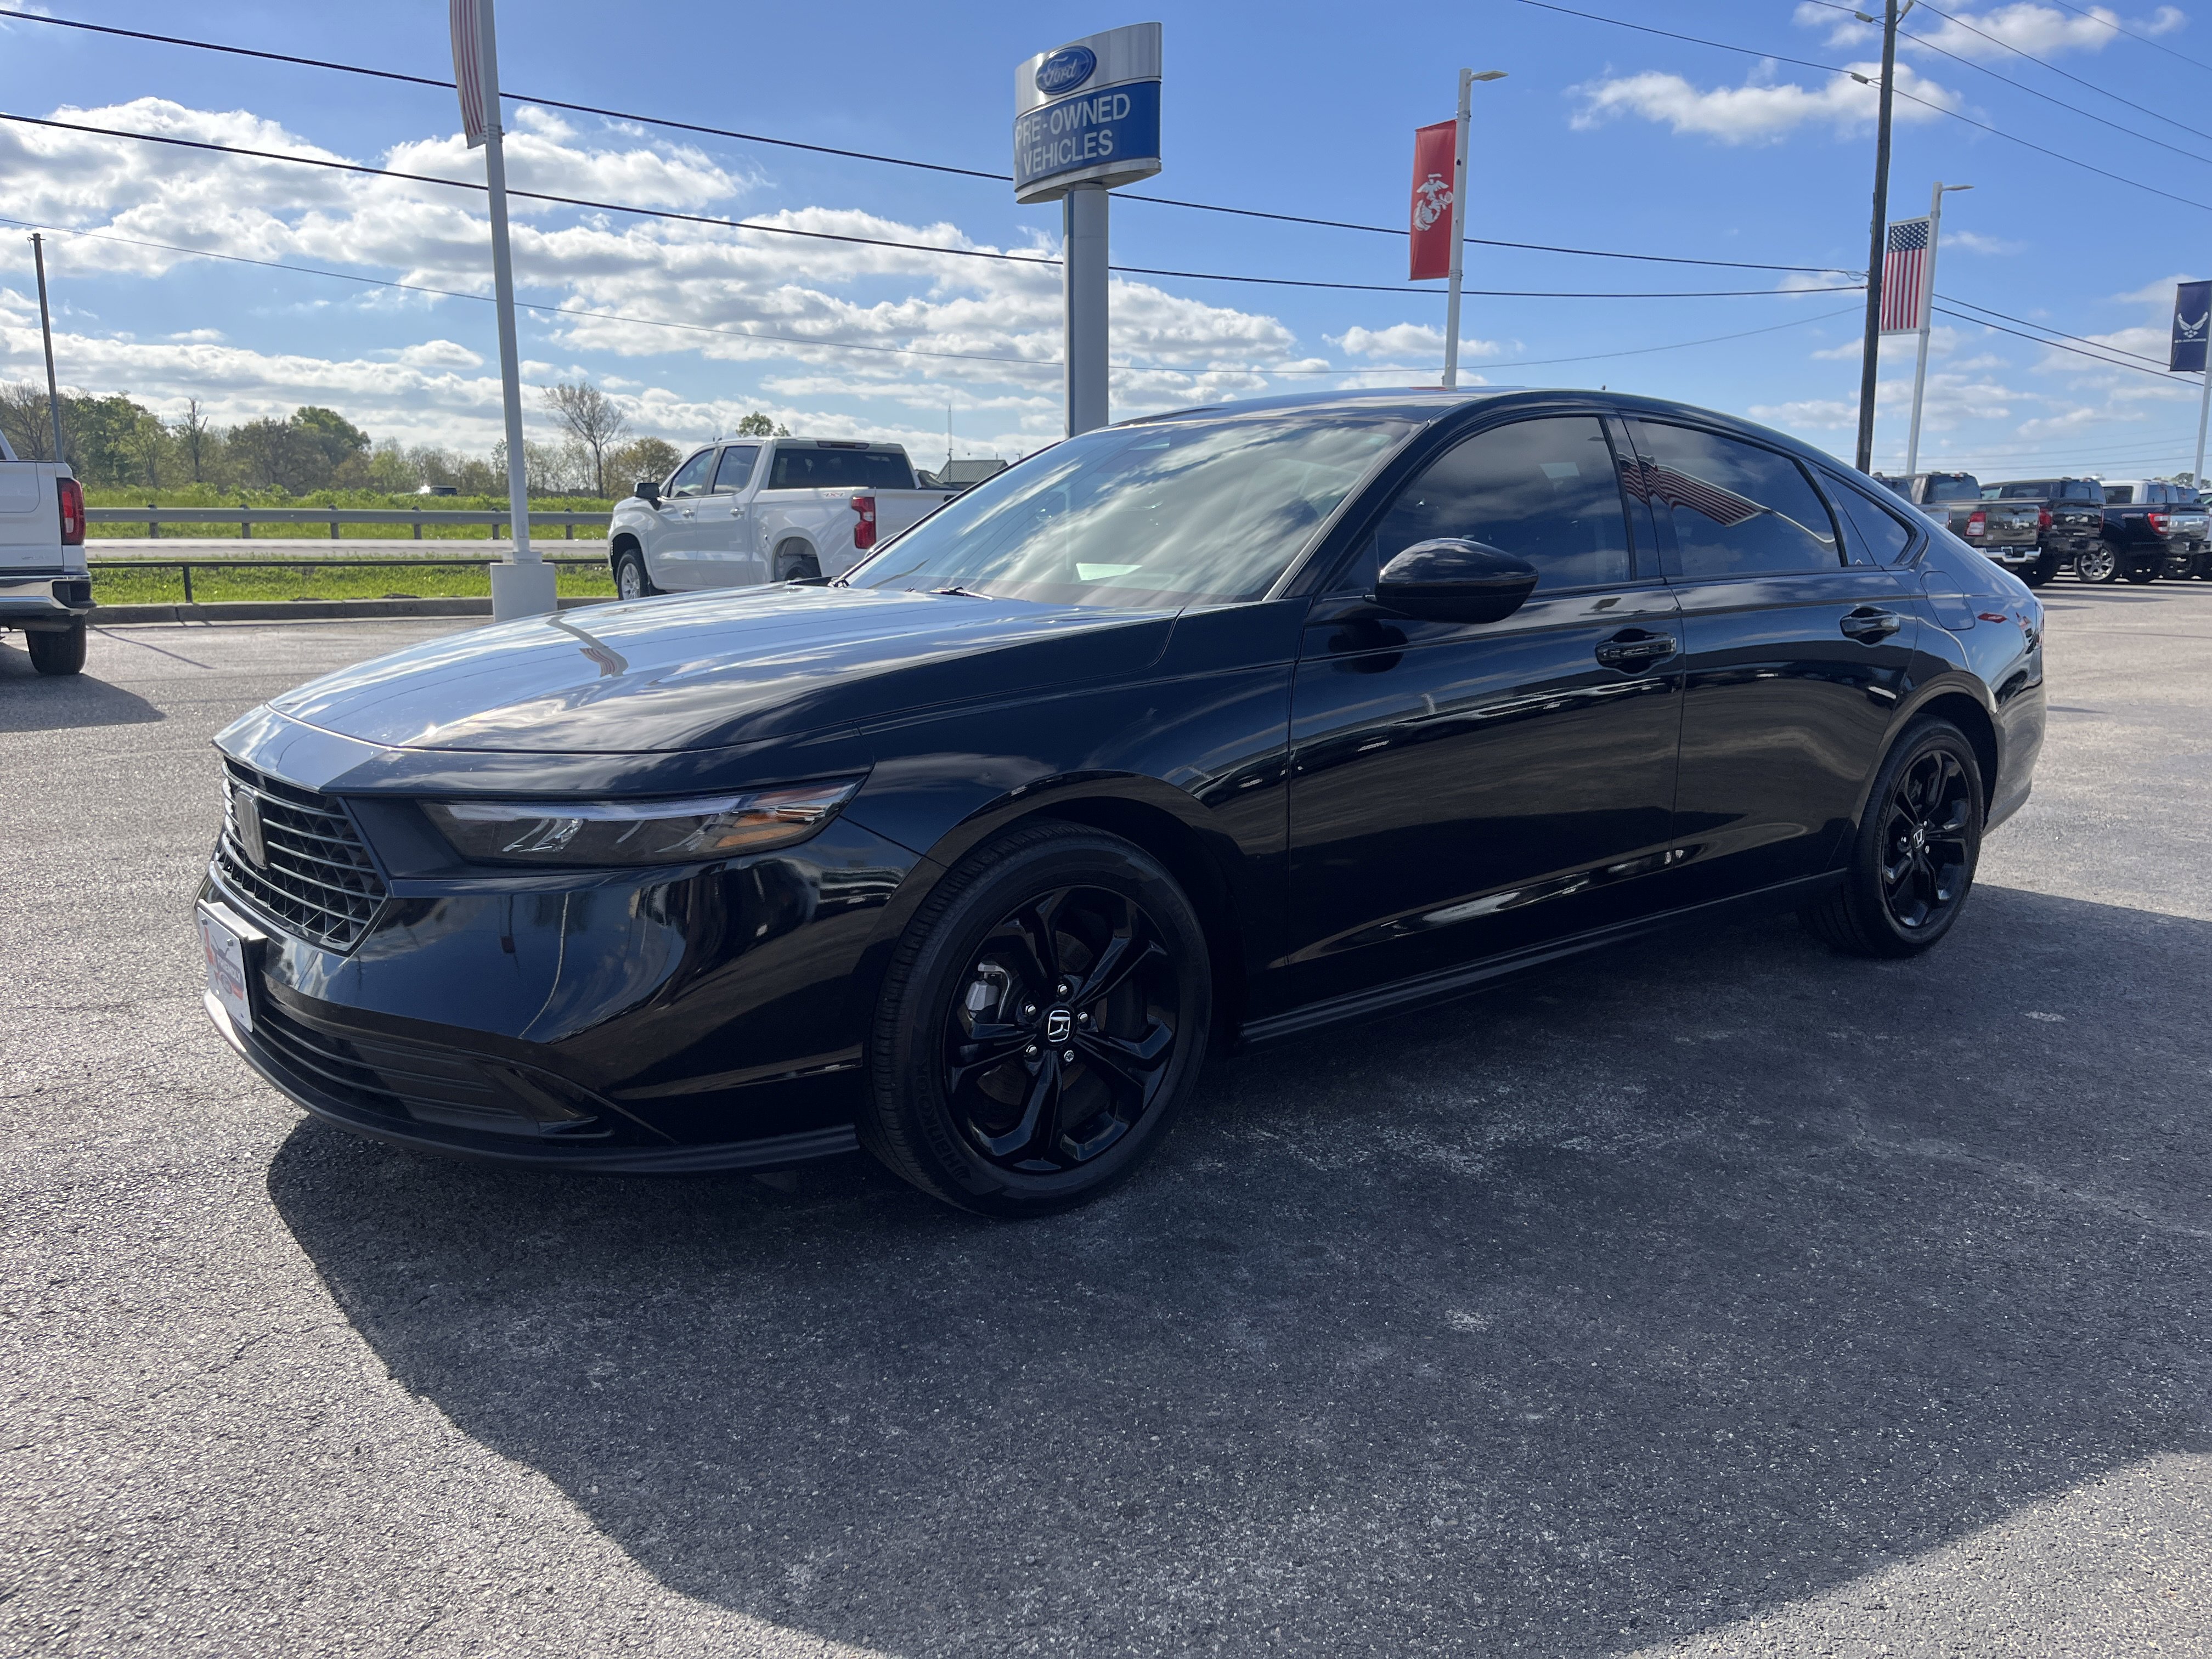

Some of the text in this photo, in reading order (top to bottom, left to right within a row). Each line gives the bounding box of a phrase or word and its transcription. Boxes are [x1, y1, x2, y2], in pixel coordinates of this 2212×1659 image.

[1043, 56, 1077, 86] Ford
[1015, 93, 1131, 150] PRE-OWNED
[1023, 129, 1114, 176] VEHICLES
